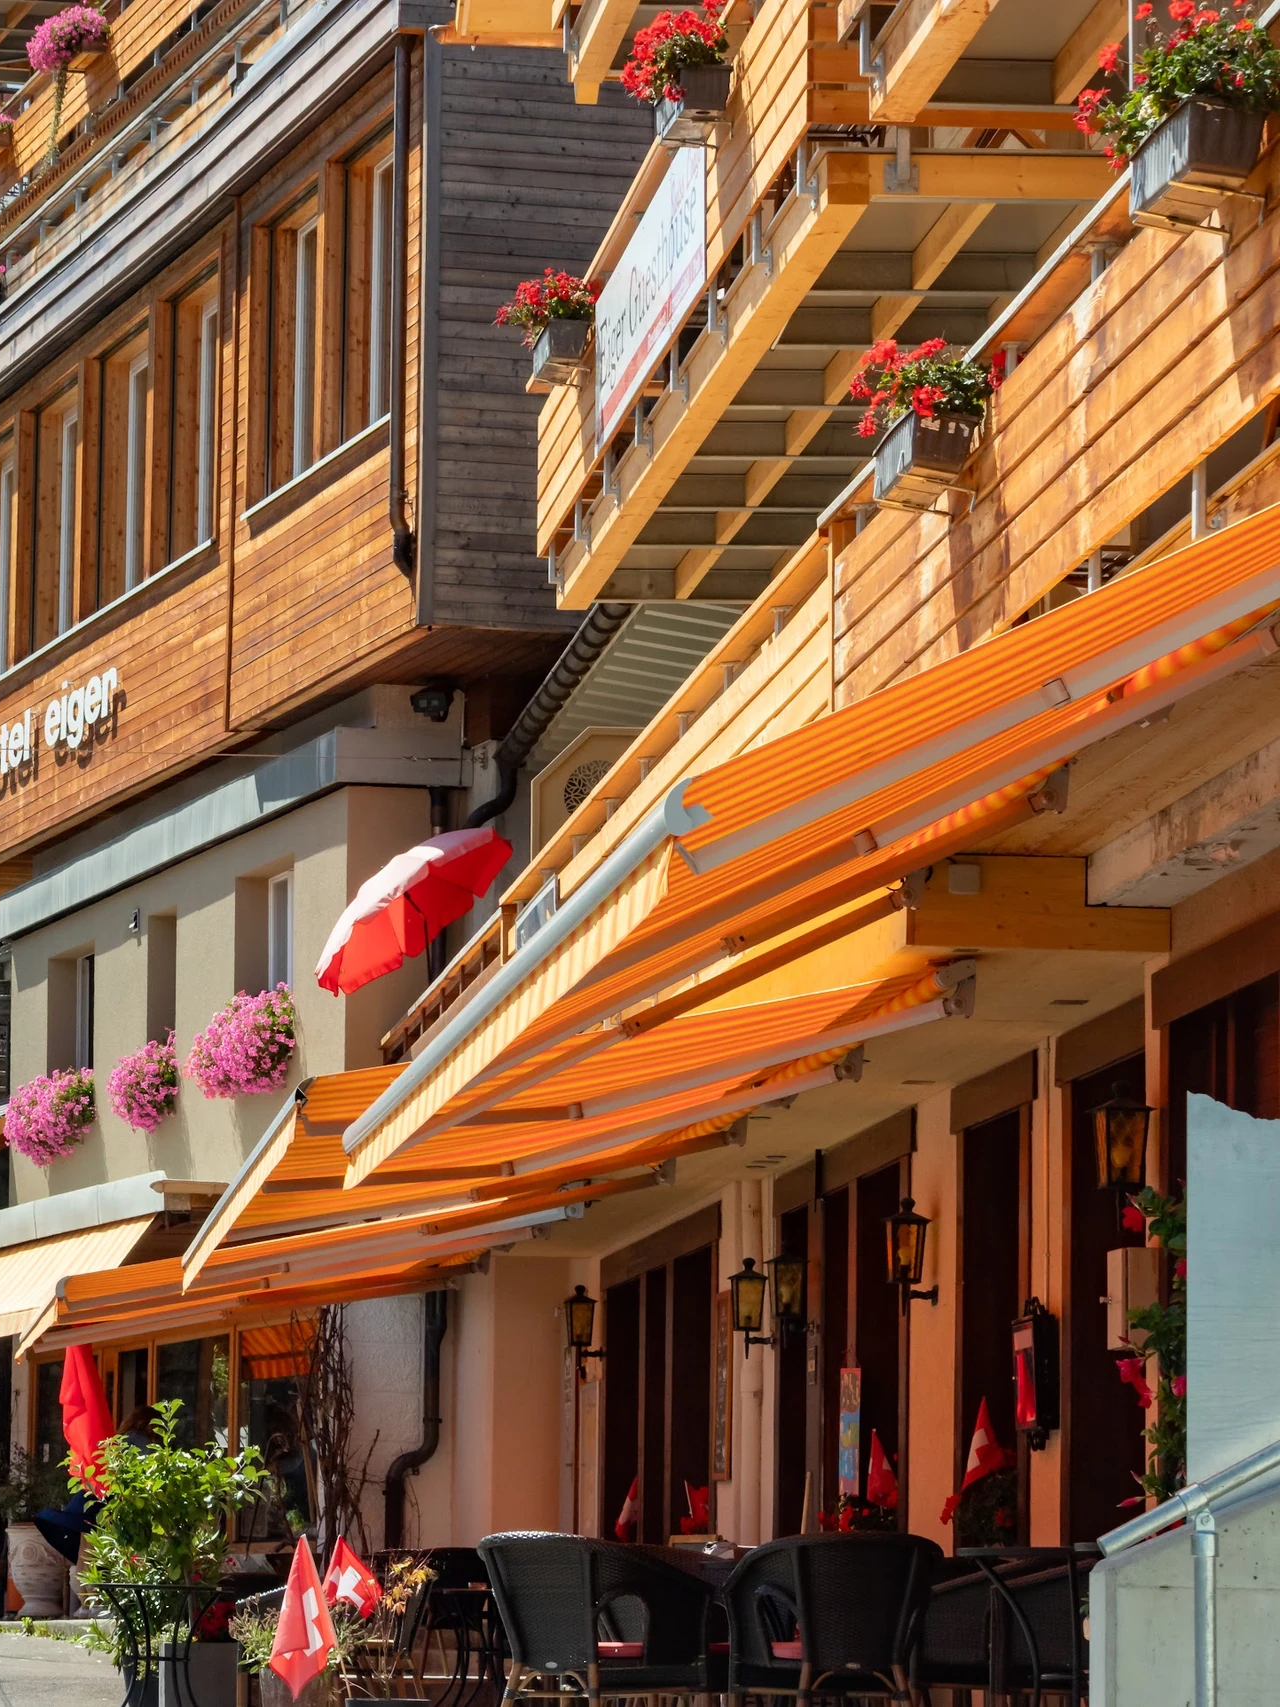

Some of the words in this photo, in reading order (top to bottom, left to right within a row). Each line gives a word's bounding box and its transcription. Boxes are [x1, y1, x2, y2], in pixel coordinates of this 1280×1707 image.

[599, 308, 626, 391] Eiger
[629, 186, 697, 337] Guesthouse
[43, 666, 118, 749] eiger
